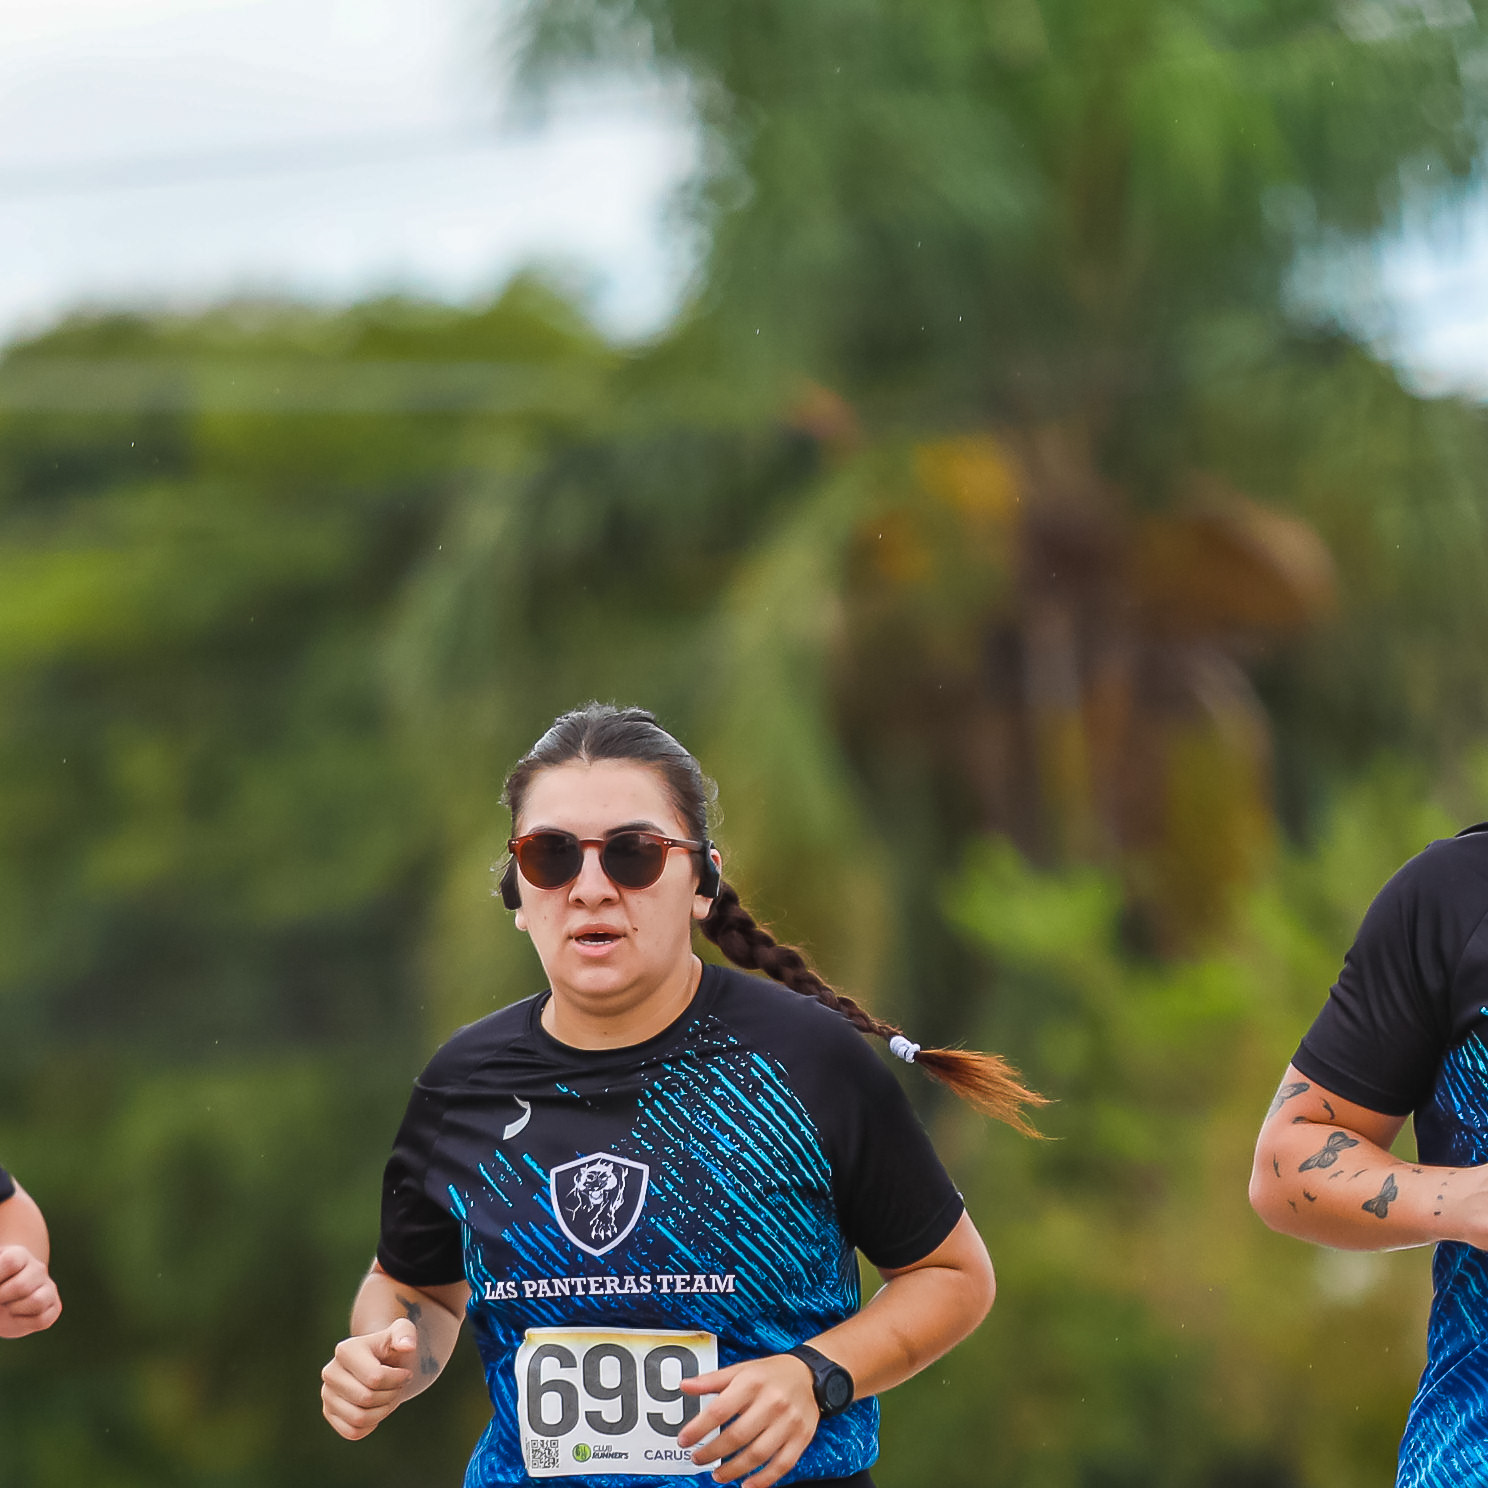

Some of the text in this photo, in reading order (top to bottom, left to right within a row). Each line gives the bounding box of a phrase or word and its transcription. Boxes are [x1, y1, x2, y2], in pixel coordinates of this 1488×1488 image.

[484, 1274, 736, 1300] LAS PANTERAS TEAM
[526, 1343, 701, 1438] 699
[592, 1444, 613, 1452] CLUB
[644, 1449, 693, 1461] CARUS
